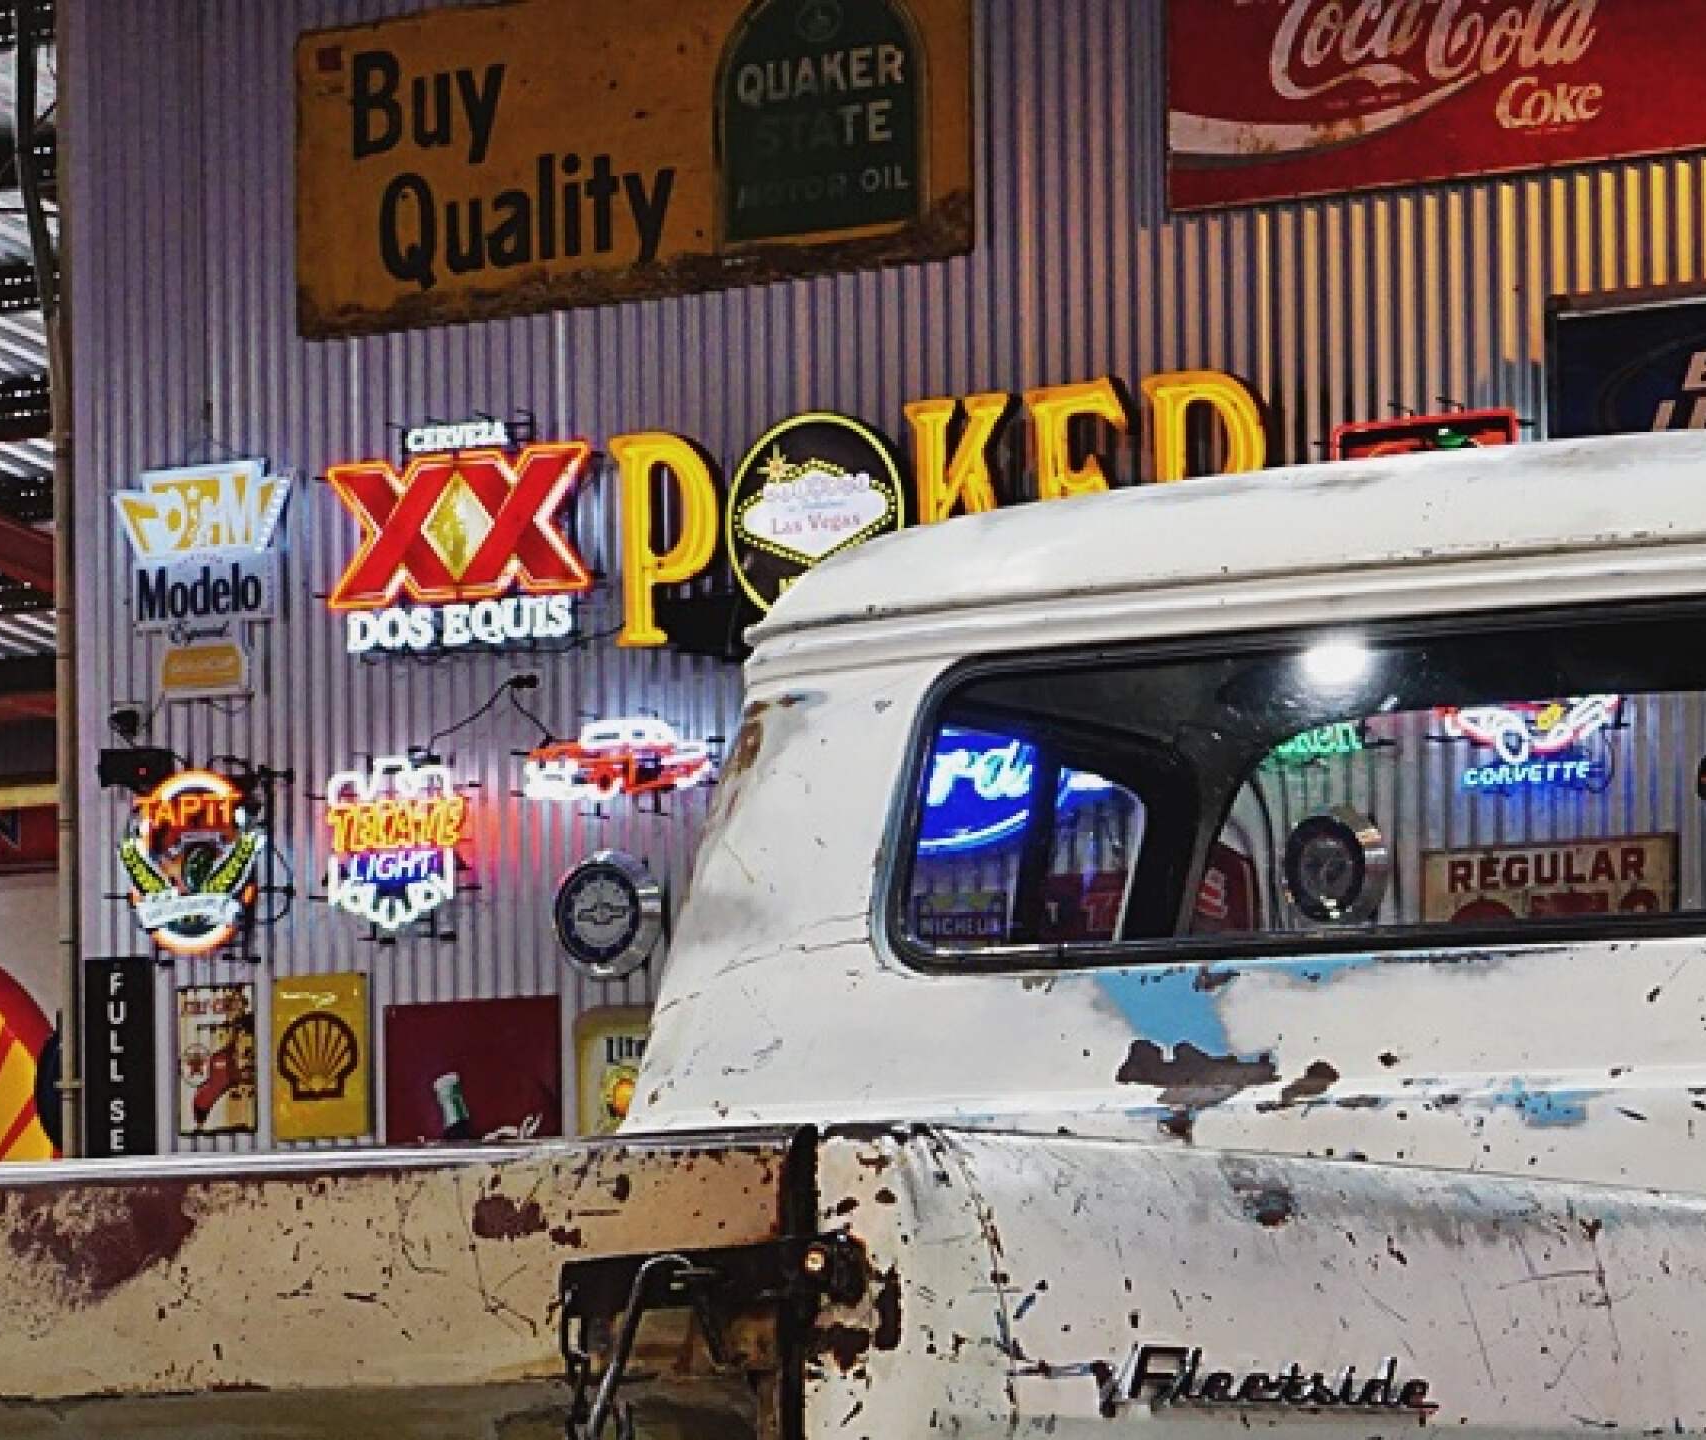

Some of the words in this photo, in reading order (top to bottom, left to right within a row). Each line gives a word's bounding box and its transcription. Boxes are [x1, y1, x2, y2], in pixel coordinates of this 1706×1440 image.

[737, 43, 905, 107] QUAKER
[1496, 76, 1604, 129] Coke
[351, 50, 505, 164] Buy
[860, 163, 910, 193] OIL
[378, 153, 677, 289] Quality
[327, 440, 593, 612] XX
[136, 562, 263, 622] Modelo
[346, 604, 438, 654] DOS
[442, 594, 574, 644] EQUIS
[1462, 759, 1592, 788] CORVETTE
[350, 850, 440, 882] LIGHT
[1446, 846, 1646, 896] REGULAR
[106, 972, 129, 1083] FULL
[1094, 1341, 1439, 1417] Fleetside
